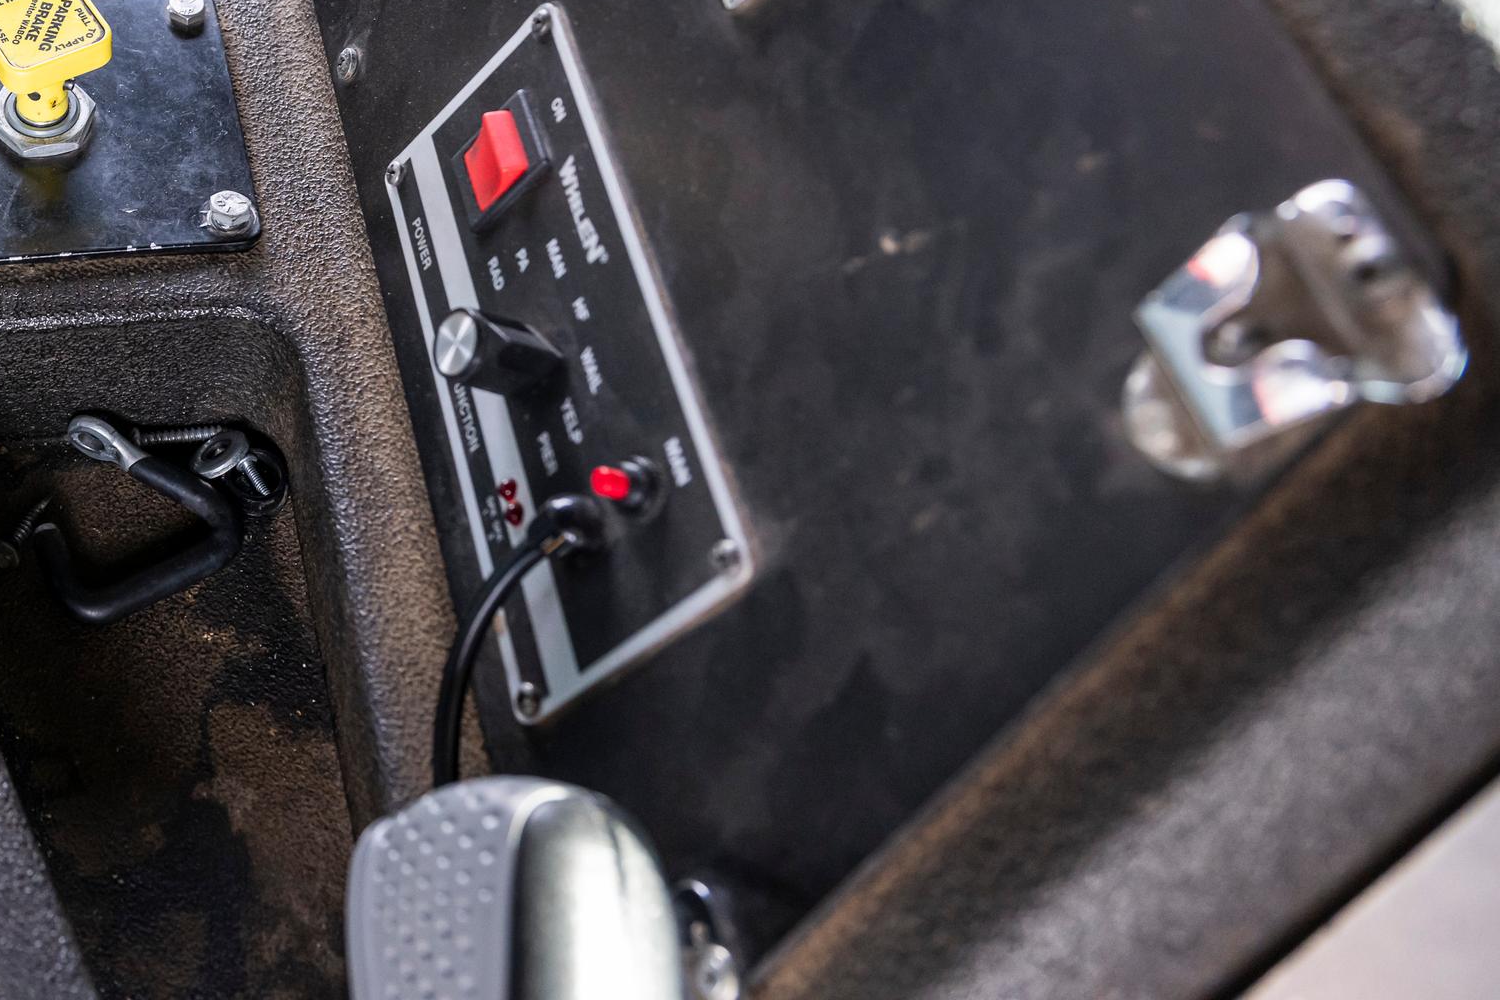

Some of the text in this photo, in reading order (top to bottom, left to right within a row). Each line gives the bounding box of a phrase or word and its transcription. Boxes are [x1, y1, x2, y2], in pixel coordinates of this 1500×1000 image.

[12, 18, 30, 45] WABCO
[25, 2, 53, 42] BRAKE
[54, 7, 97, 52] PULL TO APPLY
[550, 96, 568, 123] ON
[411, 216, 433, 271] POWER
[515, 247, 530, 273] PA
[545, 237, 568, 280] MAN
[487, 255, 505, 291] RAD
[453, 382, 481, 453] UNCTION
[560, 396, 584, 445] YELP
